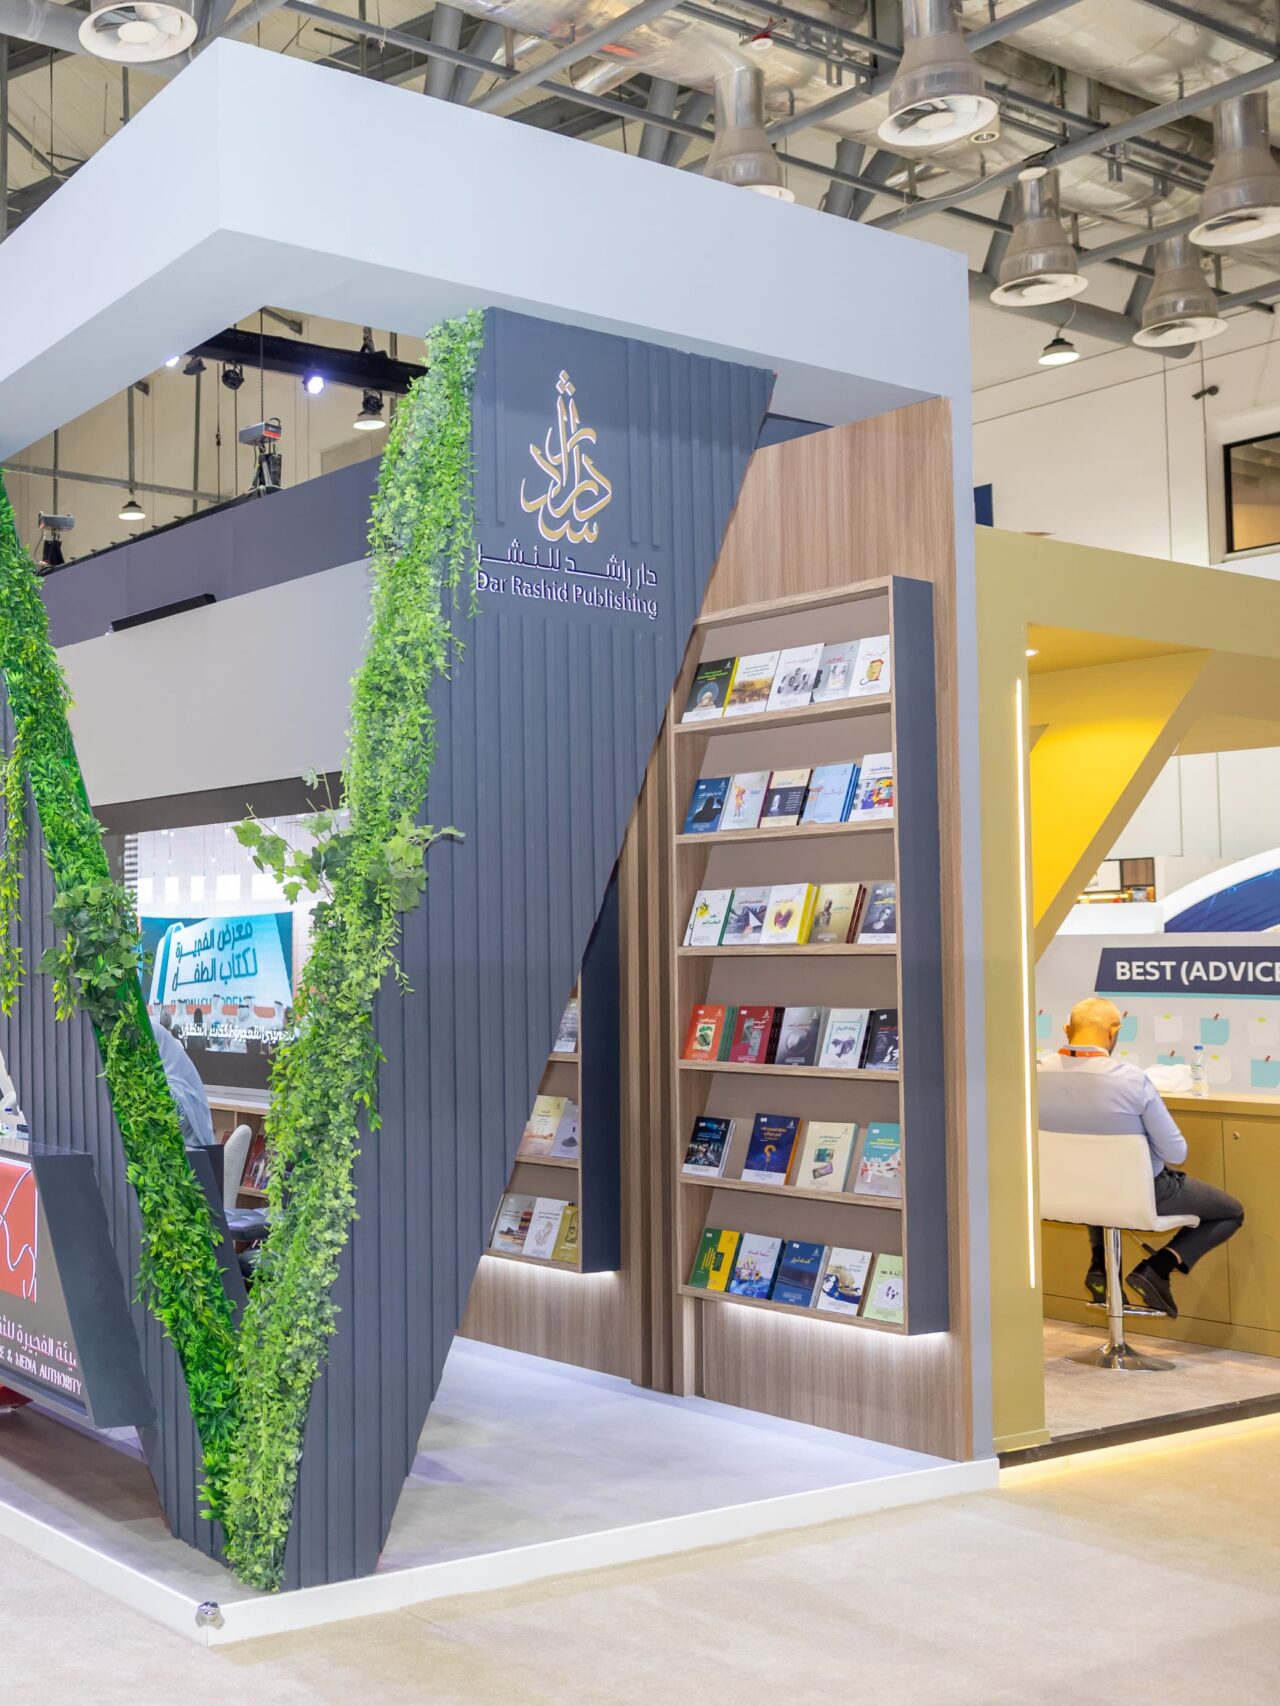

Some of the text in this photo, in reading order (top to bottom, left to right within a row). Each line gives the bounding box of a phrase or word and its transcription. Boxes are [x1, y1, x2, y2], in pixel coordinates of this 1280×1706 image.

[477, 539, 657, 590] دار راشد للنشر
[476, 570, 658, 620] Dar Rashid Publishing
[176, 922, 253, 963] معرض الفجيرة
[172, 947, 258, 992] لكتاب الطفل
[1115, 961, 1176, 981] BEST
[17, 1324, 53, 1357] الفجيرة
[56, 1340, 77, 1372] يئة
[6, 1349, 13, 1364] &
[15, 1352, 37, 1375] MEDIA
[39, 1363, 82, 1395] AUTHORITY
